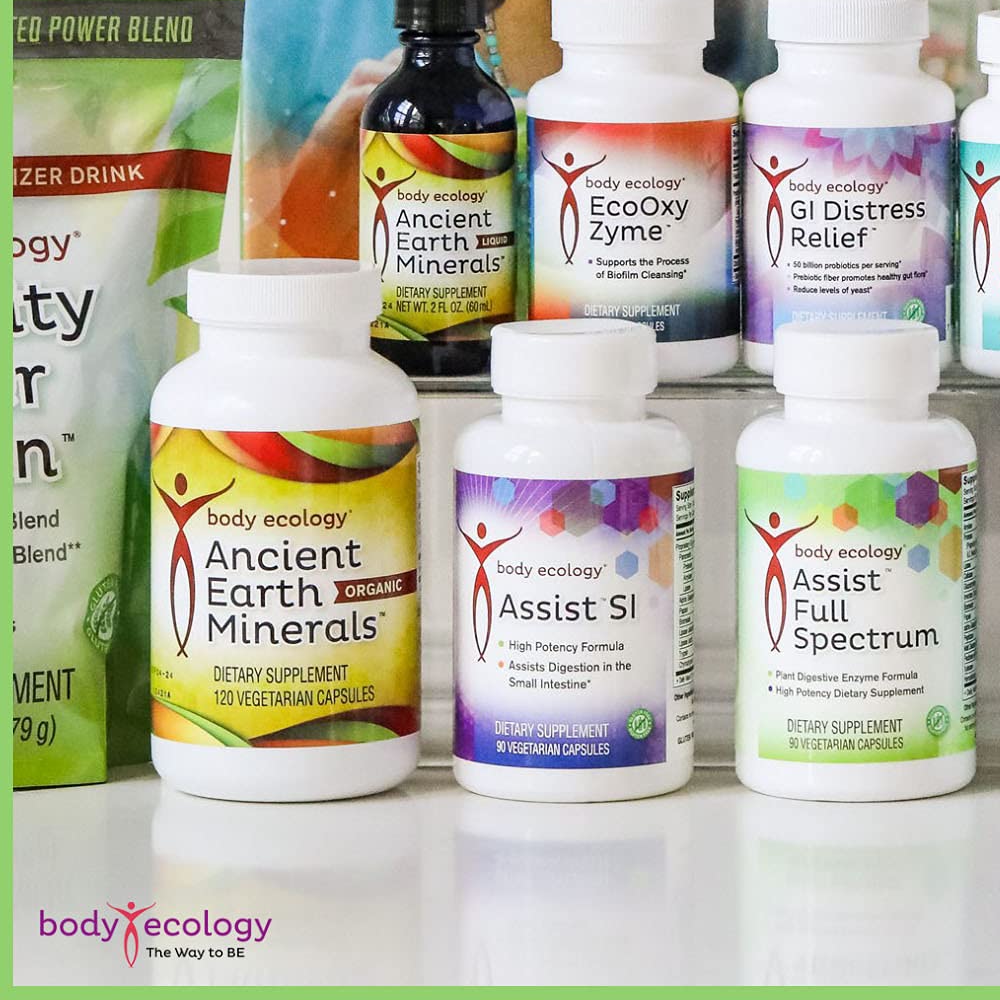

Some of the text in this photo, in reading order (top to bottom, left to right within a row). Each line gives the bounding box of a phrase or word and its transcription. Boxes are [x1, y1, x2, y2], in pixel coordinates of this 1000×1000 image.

[12, 16, 193, 43] ED POWER BLEND
[70, 164, 145, 184] DRINK
[585, 176, 621, 191] body
[397, 189, 430, 204] body
[789, 179, 822, 195] body
[590, 195, 690, 221] EcoOxy
[790, 199, 926, 222] GI Distress
[395, 209, 492, 230] Ancient
[397, 232, 469, 252] Earth
[481, 235, 508, 246] LIQUID
[596, 256, 690, 269] Supports the Process
[793, 260, 801, 269] 50
[803, 260, 822, 269] billion
[823, 260, 859, 270] probiotics
[861, 261, 873, 270] per
[595, 269, 605, 280] of
[607, 269, 639, 280] Biofilm
[396, 286, 487, 299] DIETARY SUPPLEMENT
[207, 508, 256, 530] body
[204, 539, 362, 571] Ancient
[795, 544, 834, 561] body
[497, 560, 533, 578] body
[208, 576, 323, 608] Earth
[344, 579, 403, 599] ORGANIC
[499, 593, 637, 621] Assist SI
[794, 599, 849, 623] Full
[508, 640, 625, 654] High Potency Formula
[794, 626, 939, 656] Spectrum
[214, 664, 349, 684] DIETARY SUPPLEMENT
[214, 686, 375, 707] 120 VEGETARIAN CAPSULES
[495, 720, 534, 737] DIETARY
[536, 722, 609, 738] SUPPLEMENT
[788, 737, 904, 751] 90 VEGETARIAN CAPSULES
